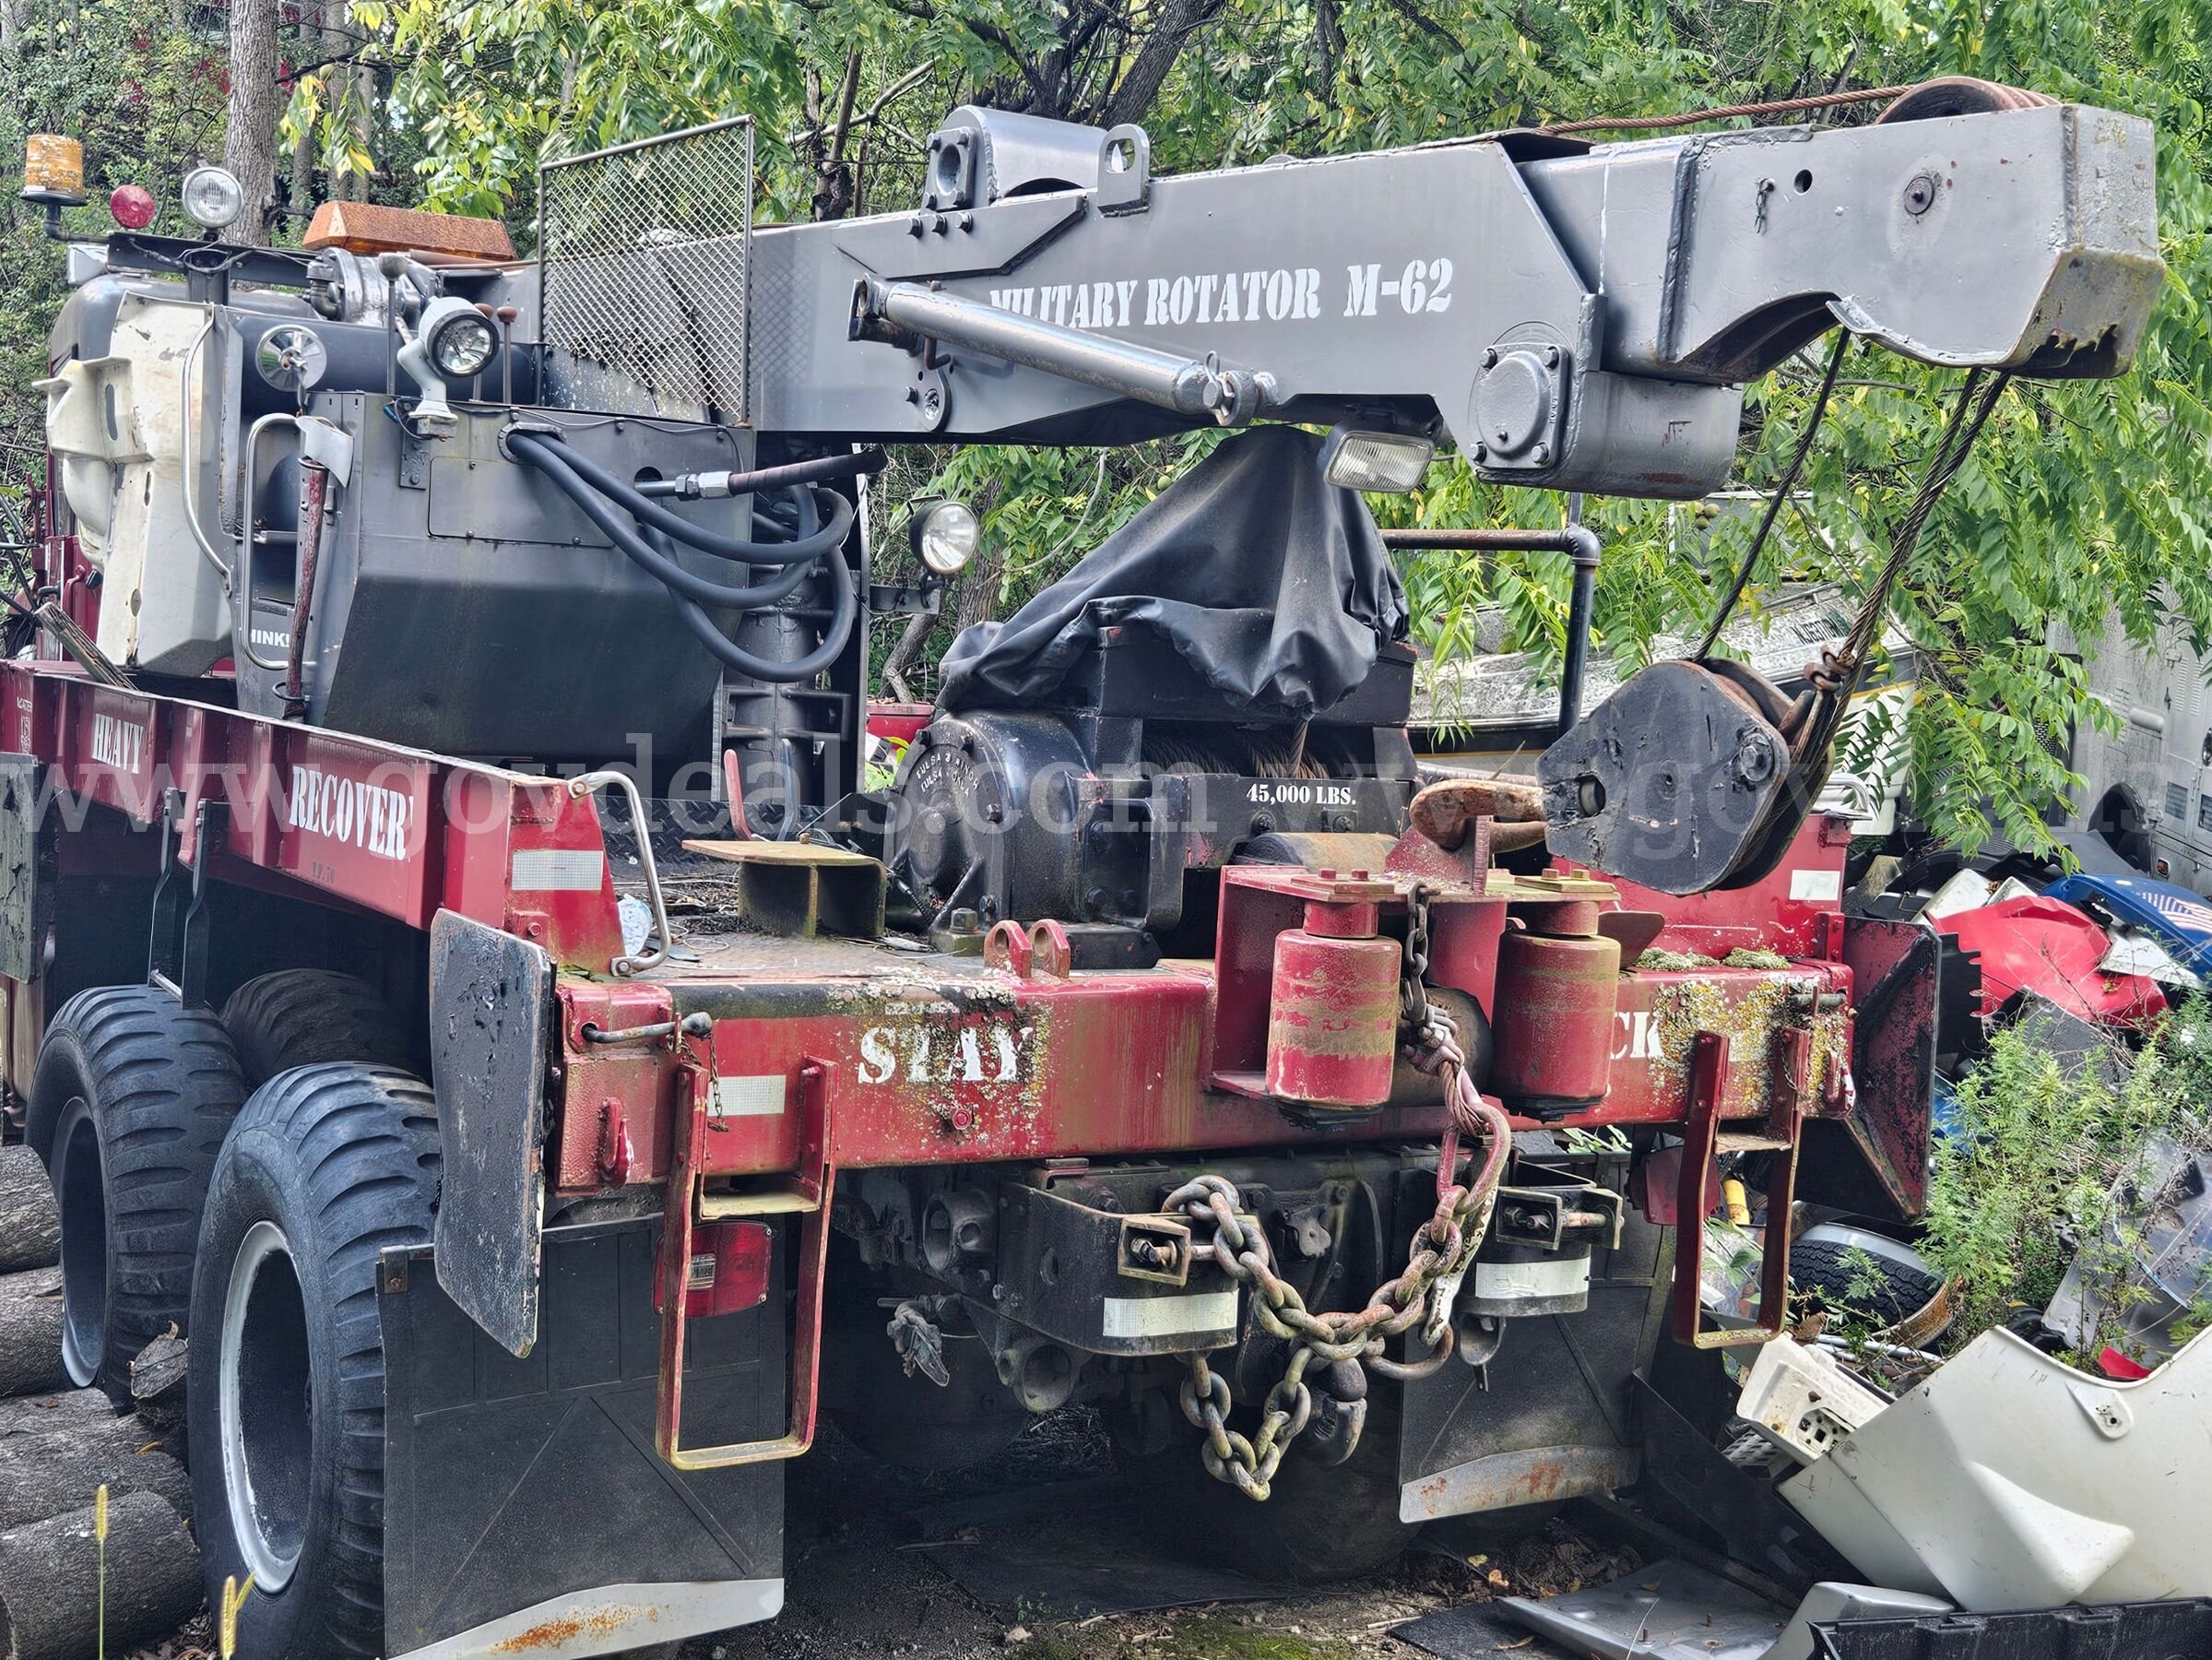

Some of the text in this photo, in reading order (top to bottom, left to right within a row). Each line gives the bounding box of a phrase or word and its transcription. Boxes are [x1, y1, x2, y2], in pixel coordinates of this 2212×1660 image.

[1144, 268, 1320, 325] ROTATOR
[1343, 257, 1453, 316] M-62
[91, 713, 145, 774] HEAVY
[1246, 783, 1357, 805] 45,000 LBS.
[857, 1024, 1034, 1085] STAY
[1610, 1011, 1665, 1061] CK
